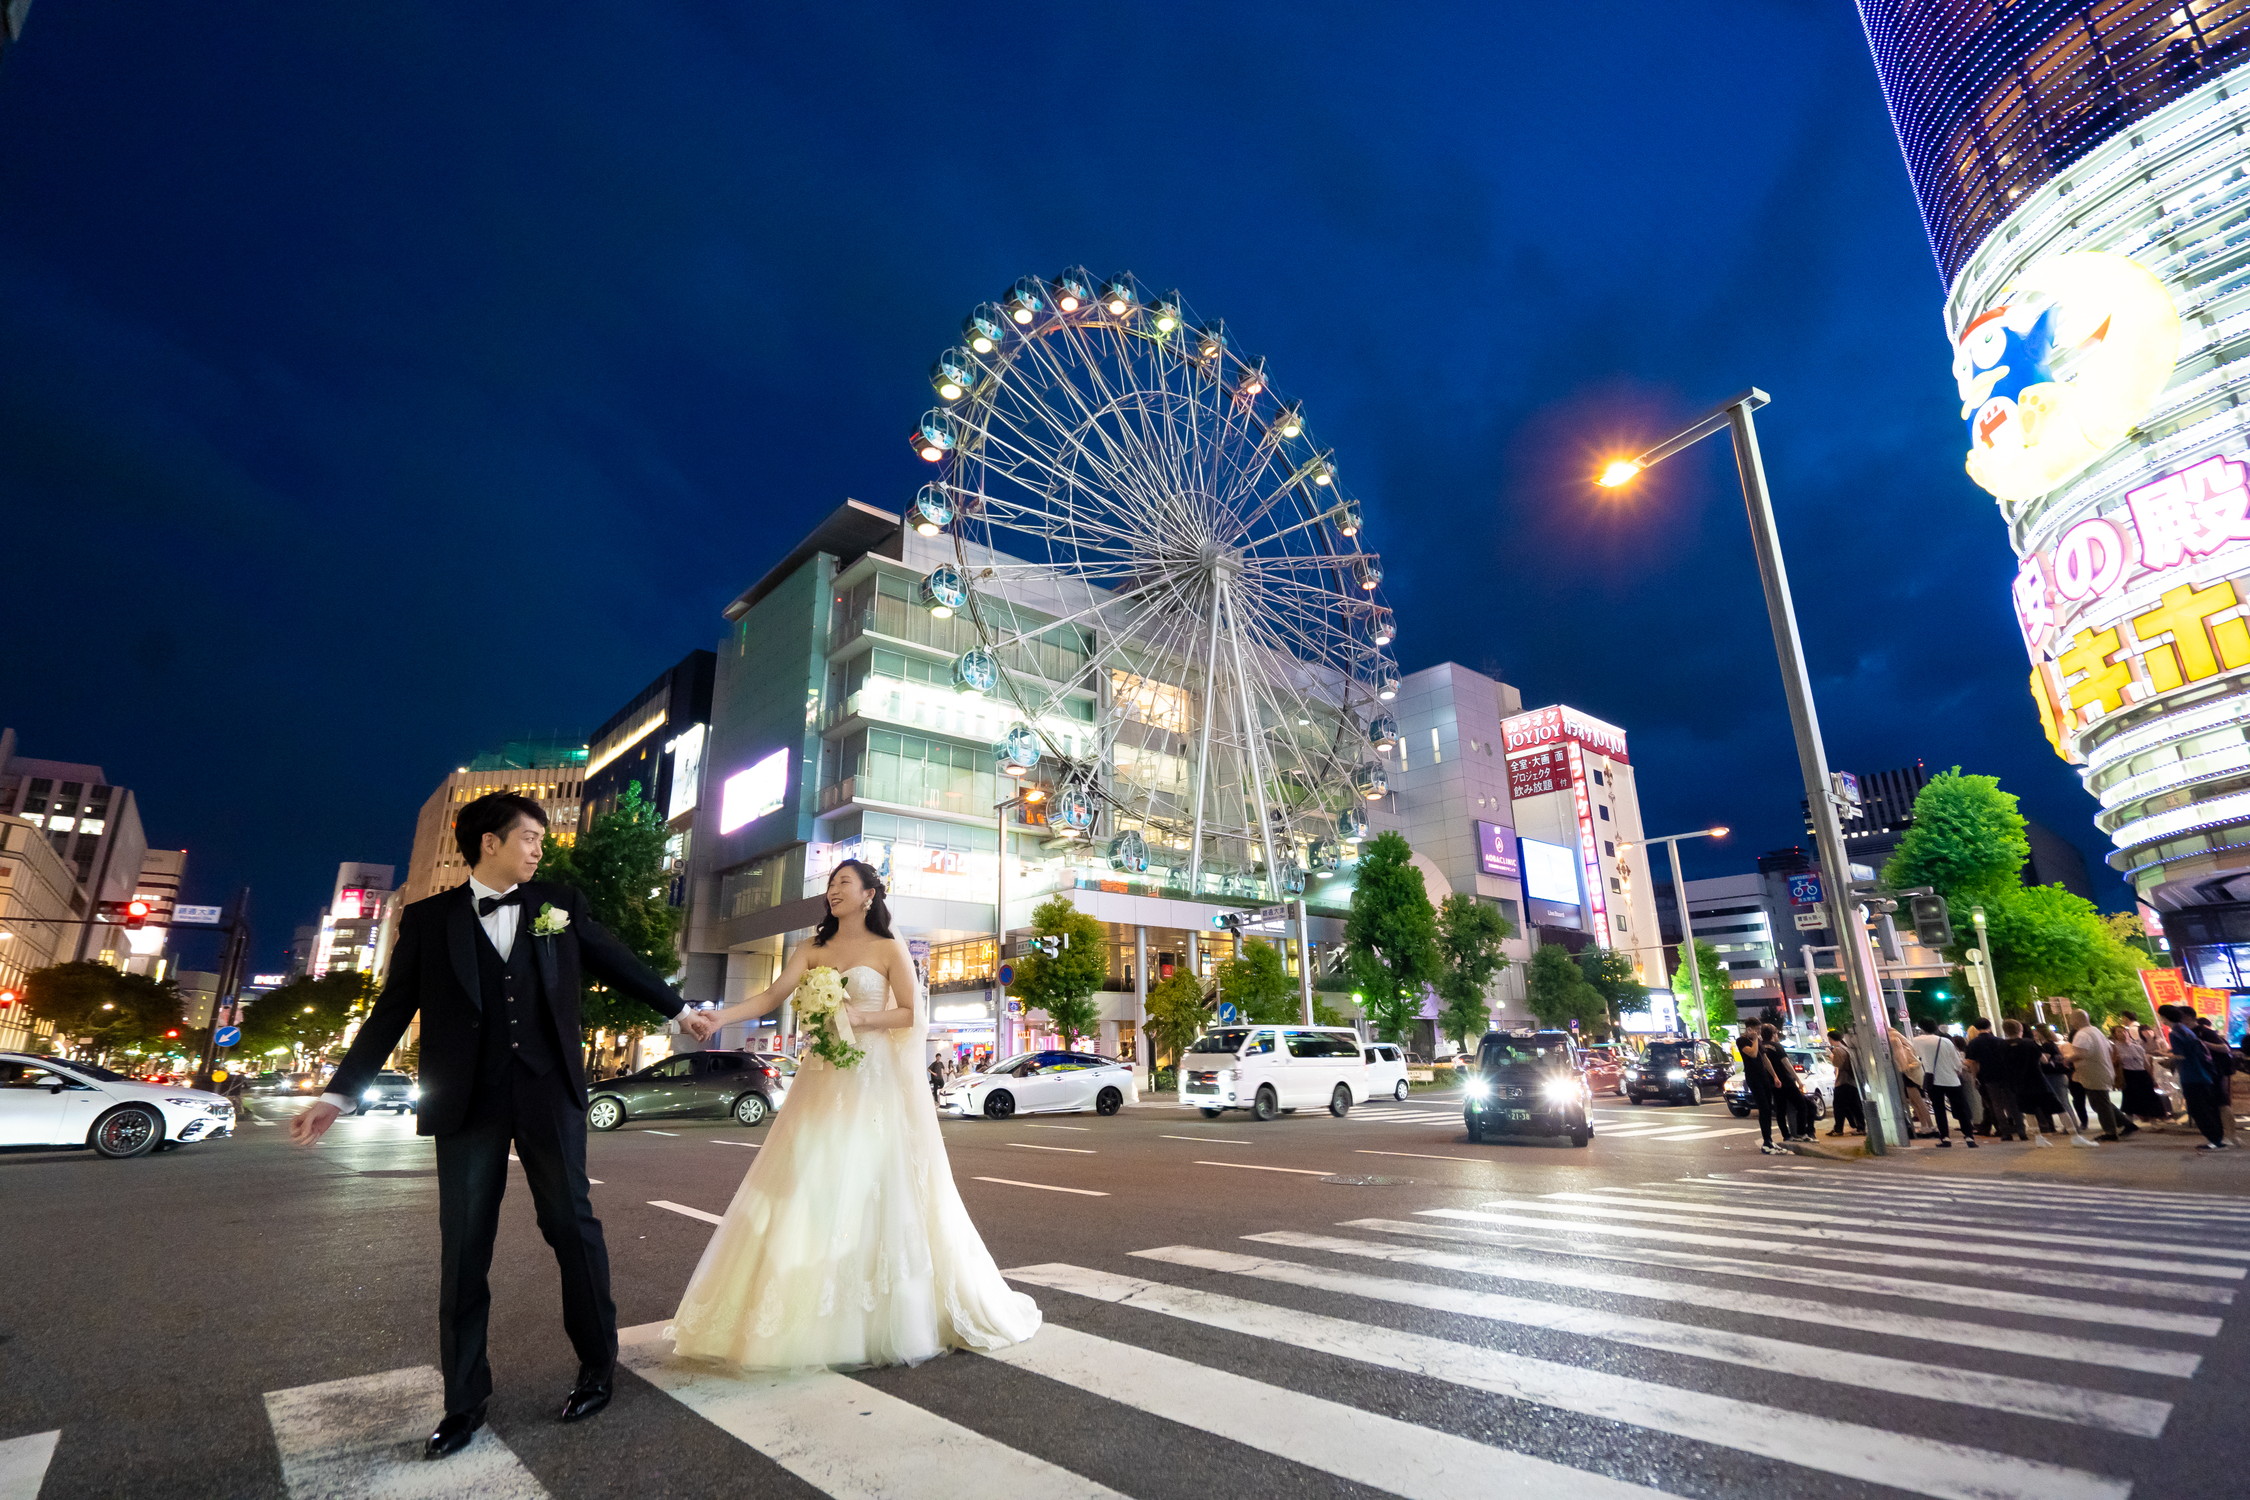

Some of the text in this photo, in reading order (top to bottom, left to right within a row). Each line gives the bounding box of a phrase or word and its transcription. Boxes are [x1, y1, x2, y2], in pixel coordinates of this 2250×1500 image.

[1508, 710, 1558, 733] カラオケ
[1507, 723, 1561, 751] JOYJOY
